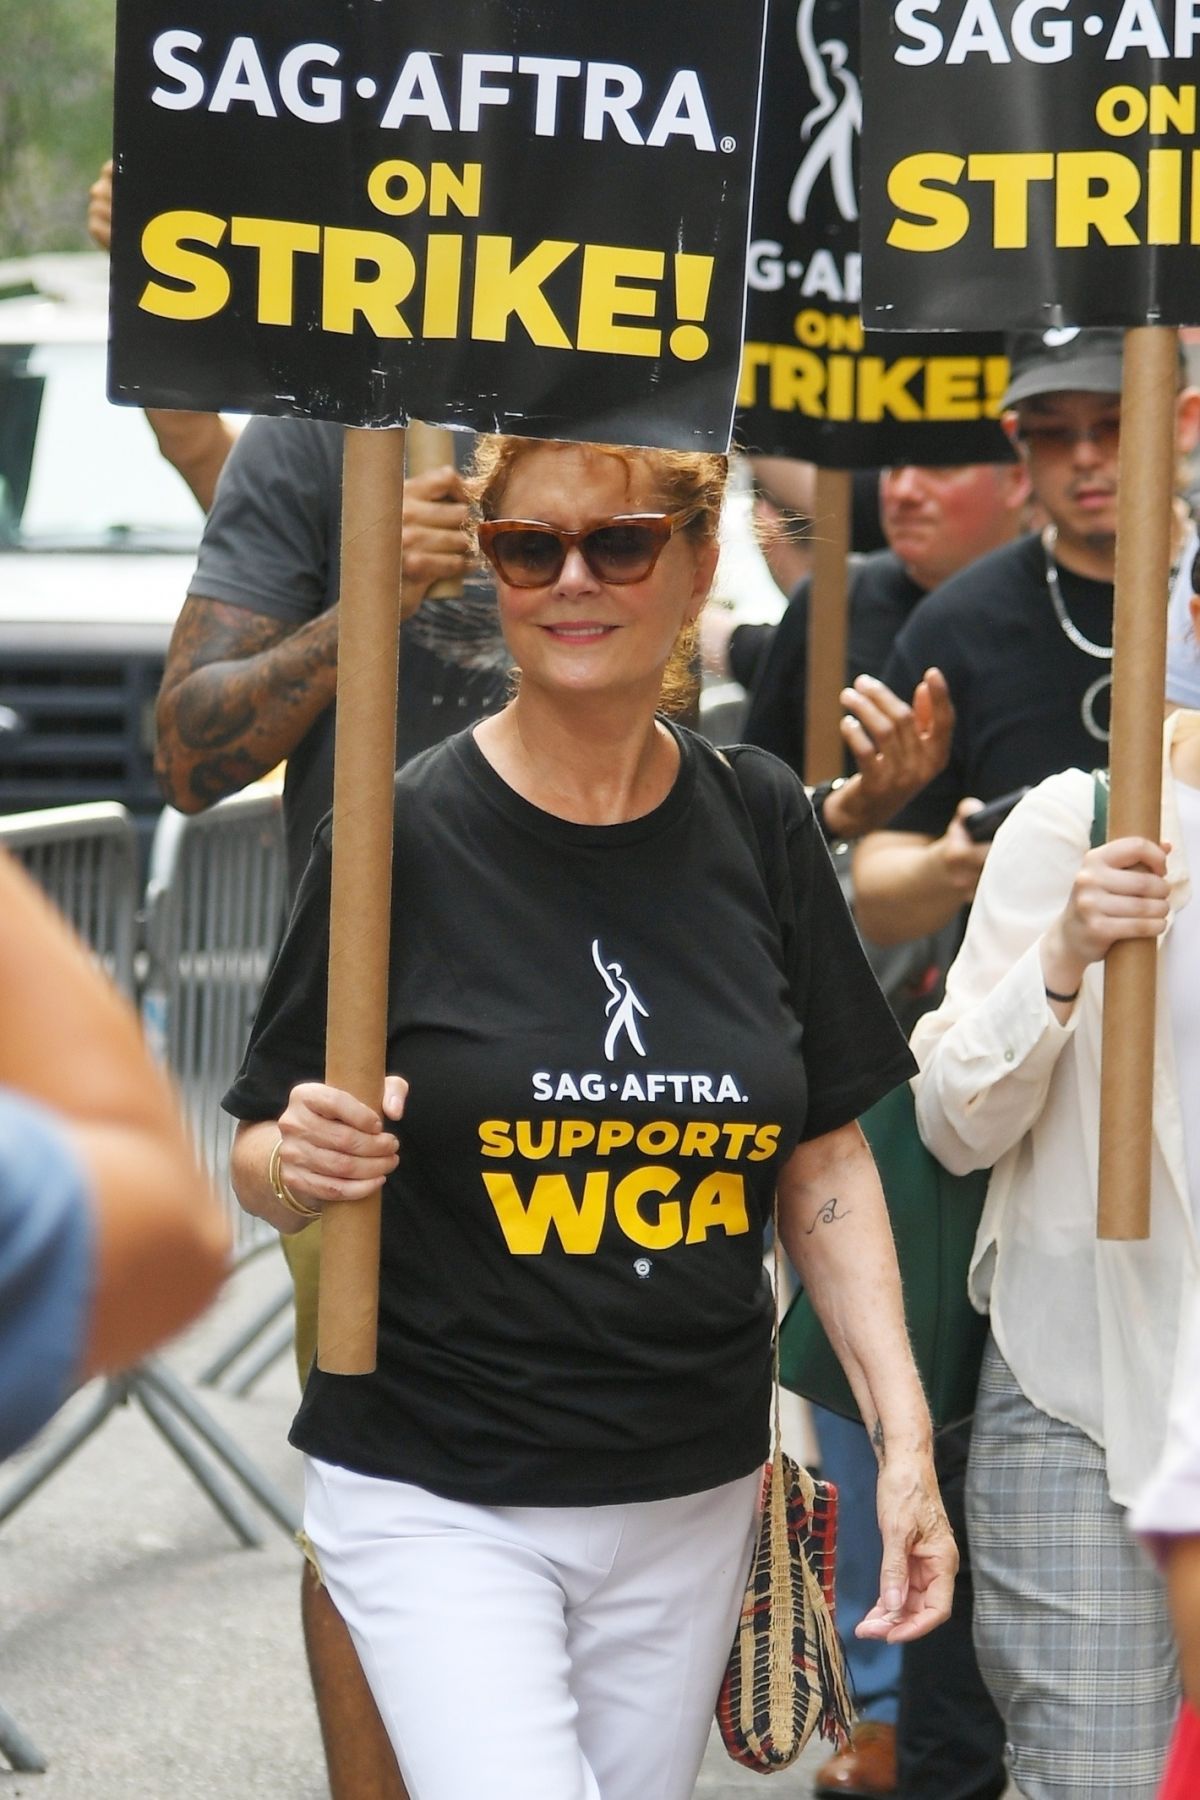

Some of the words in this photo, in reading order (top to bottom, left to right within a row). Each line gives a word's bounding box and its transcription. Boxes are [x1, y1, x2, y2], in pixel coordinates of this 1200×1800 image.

[1095, 84, 1197, 137] ON
[367, 160, 482, 217] ON
[886, 148, 1200, 251] STRI
[138, 210, 715, 361] STRIKE!
[794, 308, 865, 352] ON
[478, 1119, 782, 1162] SUPPORTS
[481, 1165, 750, 1255] WGA
